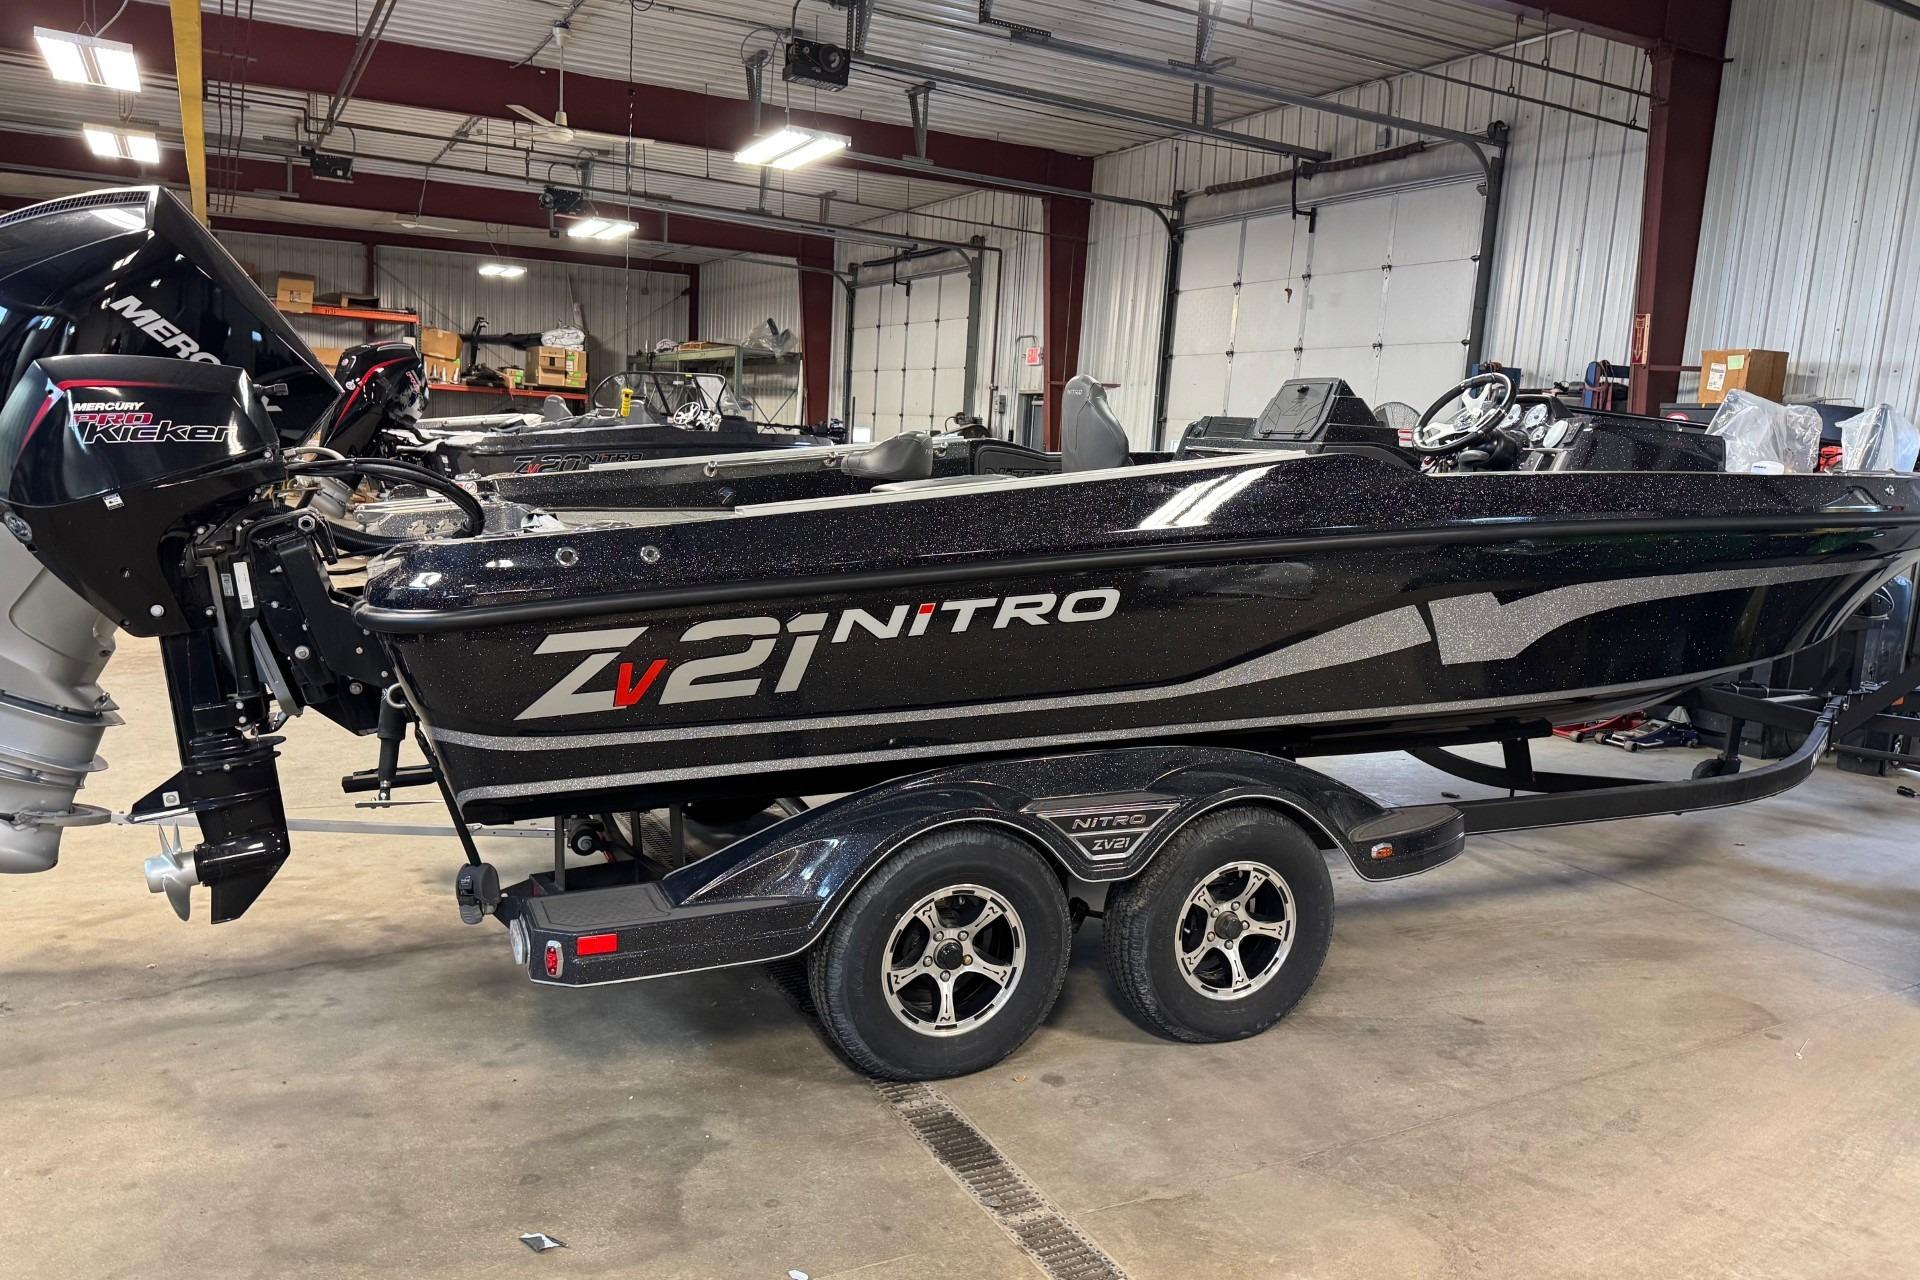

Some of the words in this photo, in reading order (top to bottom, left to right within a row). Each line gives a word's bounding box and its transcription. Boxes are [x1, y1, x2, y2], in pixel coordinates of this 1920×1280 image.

[73, 402, 144, 411] MERCURY
[70, 412, 154, 426] PRO
[84, 420, 238, 444] Kicker
[1091, 837, 1131, 851] ZV21
